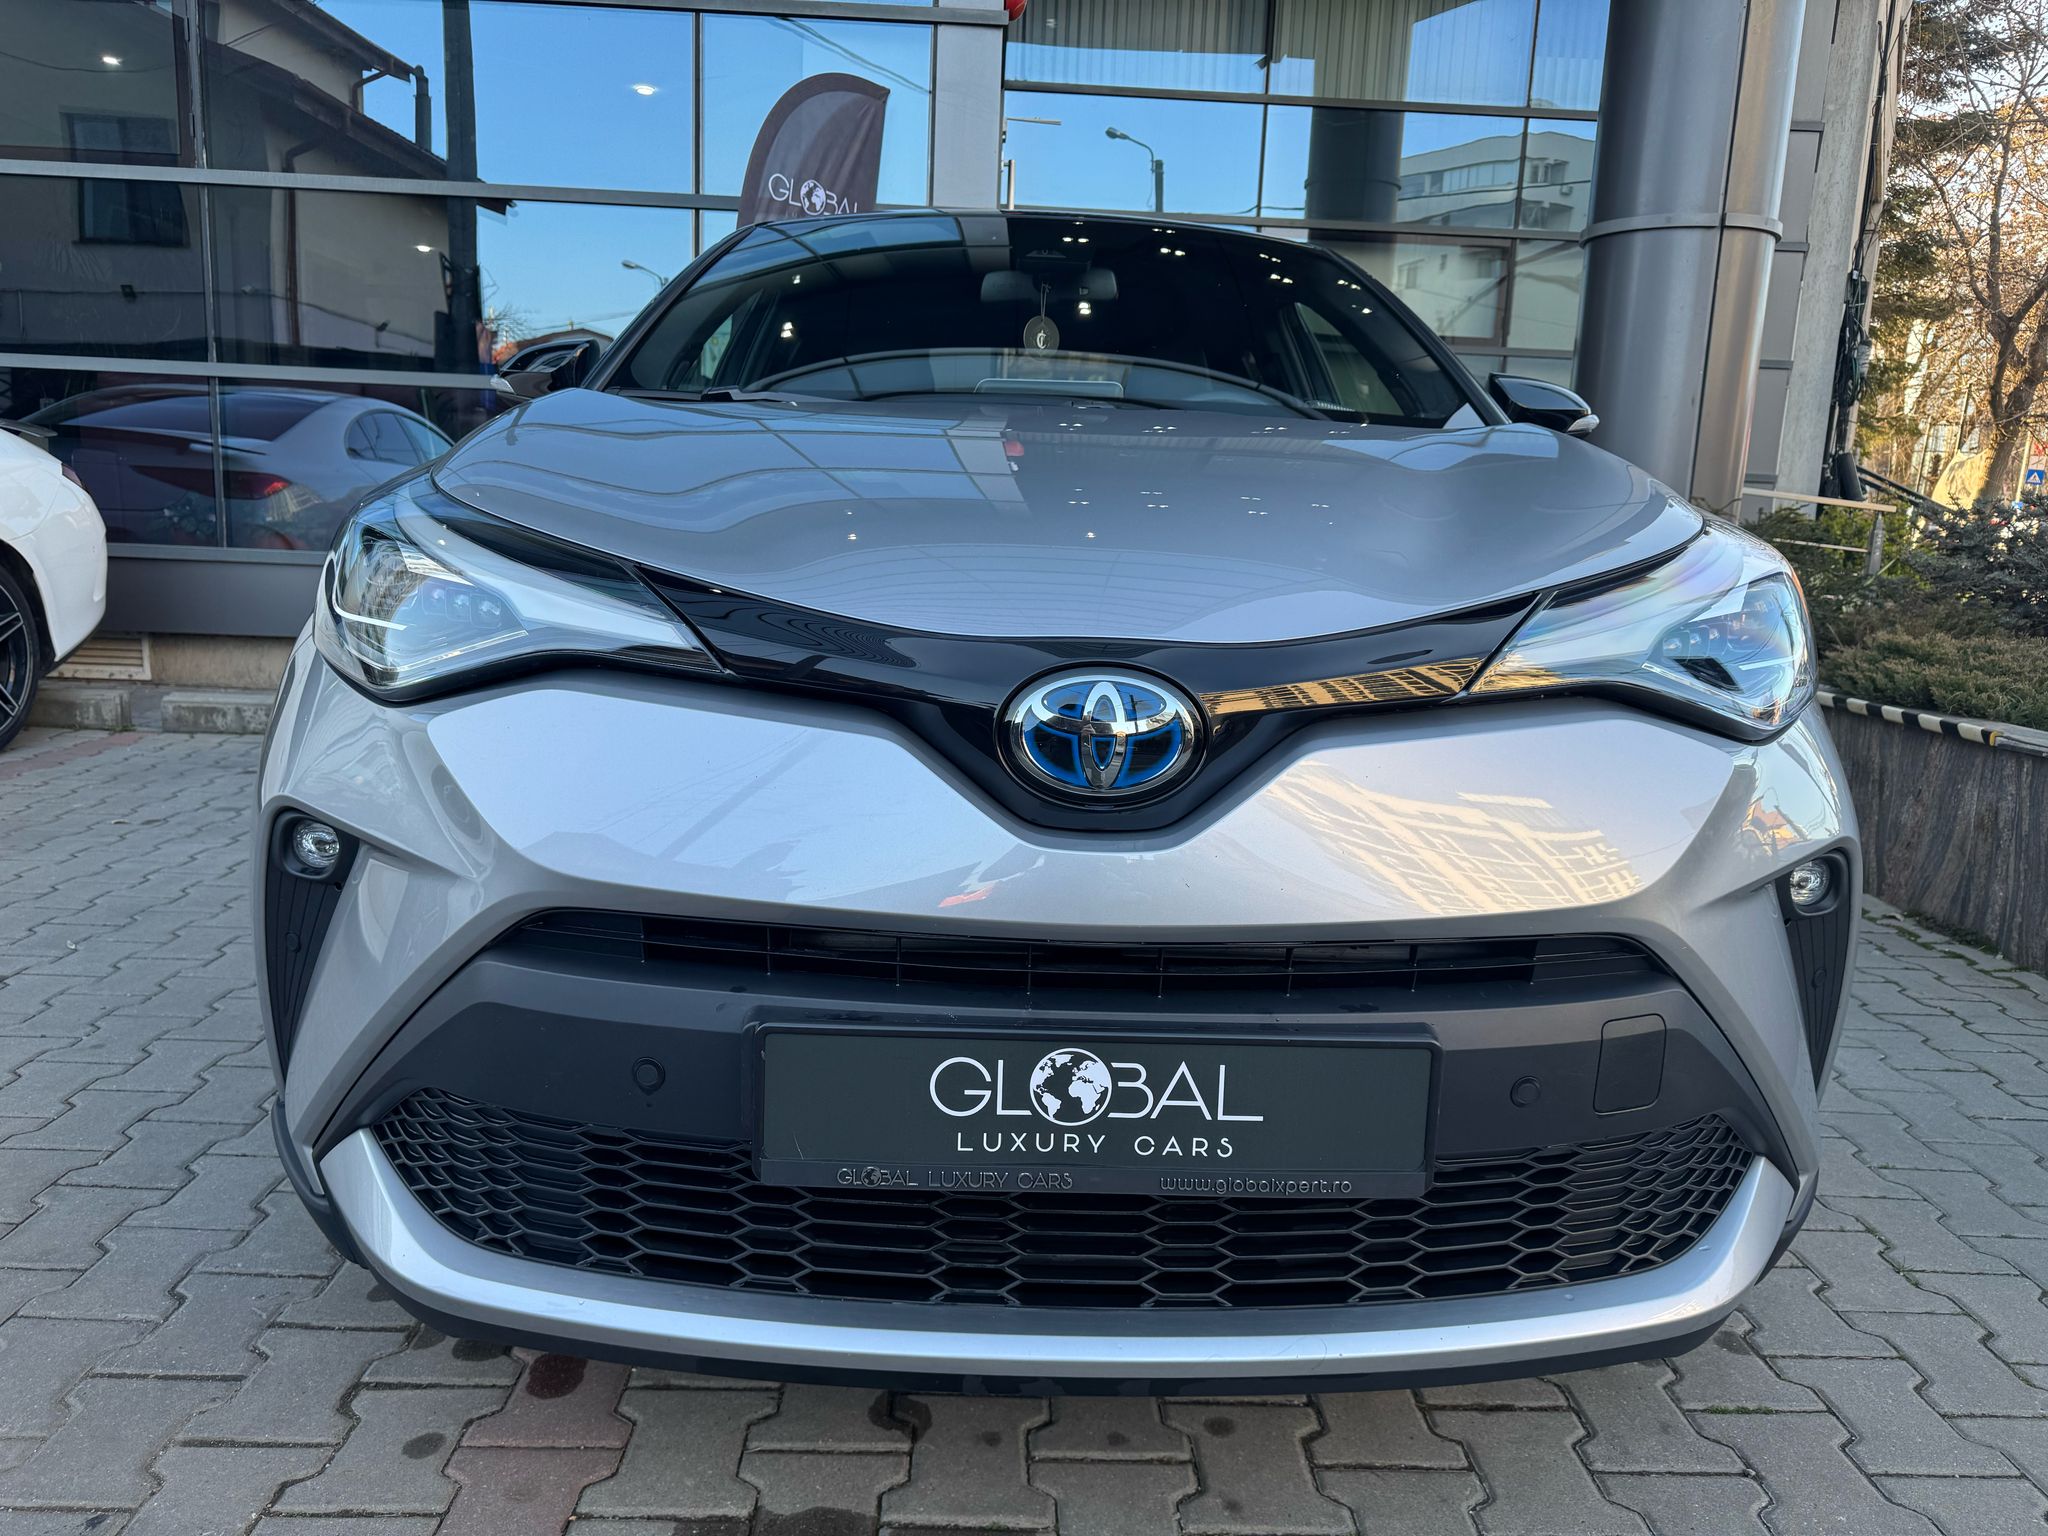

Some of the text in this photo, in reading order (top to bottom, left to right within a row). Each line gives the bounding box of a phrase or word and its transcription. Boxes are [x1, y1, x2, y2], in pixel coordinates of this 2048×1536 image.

[929, 1047, 1264, 1127] GLOBAL
[957, 1132, 1234, 1159] LUXURY CARS
[837, 1166, 1073, 1189] GLOBAL LUXURY CARS
[1160, 1177, 1352, 1195] www.globalxpert.ro
